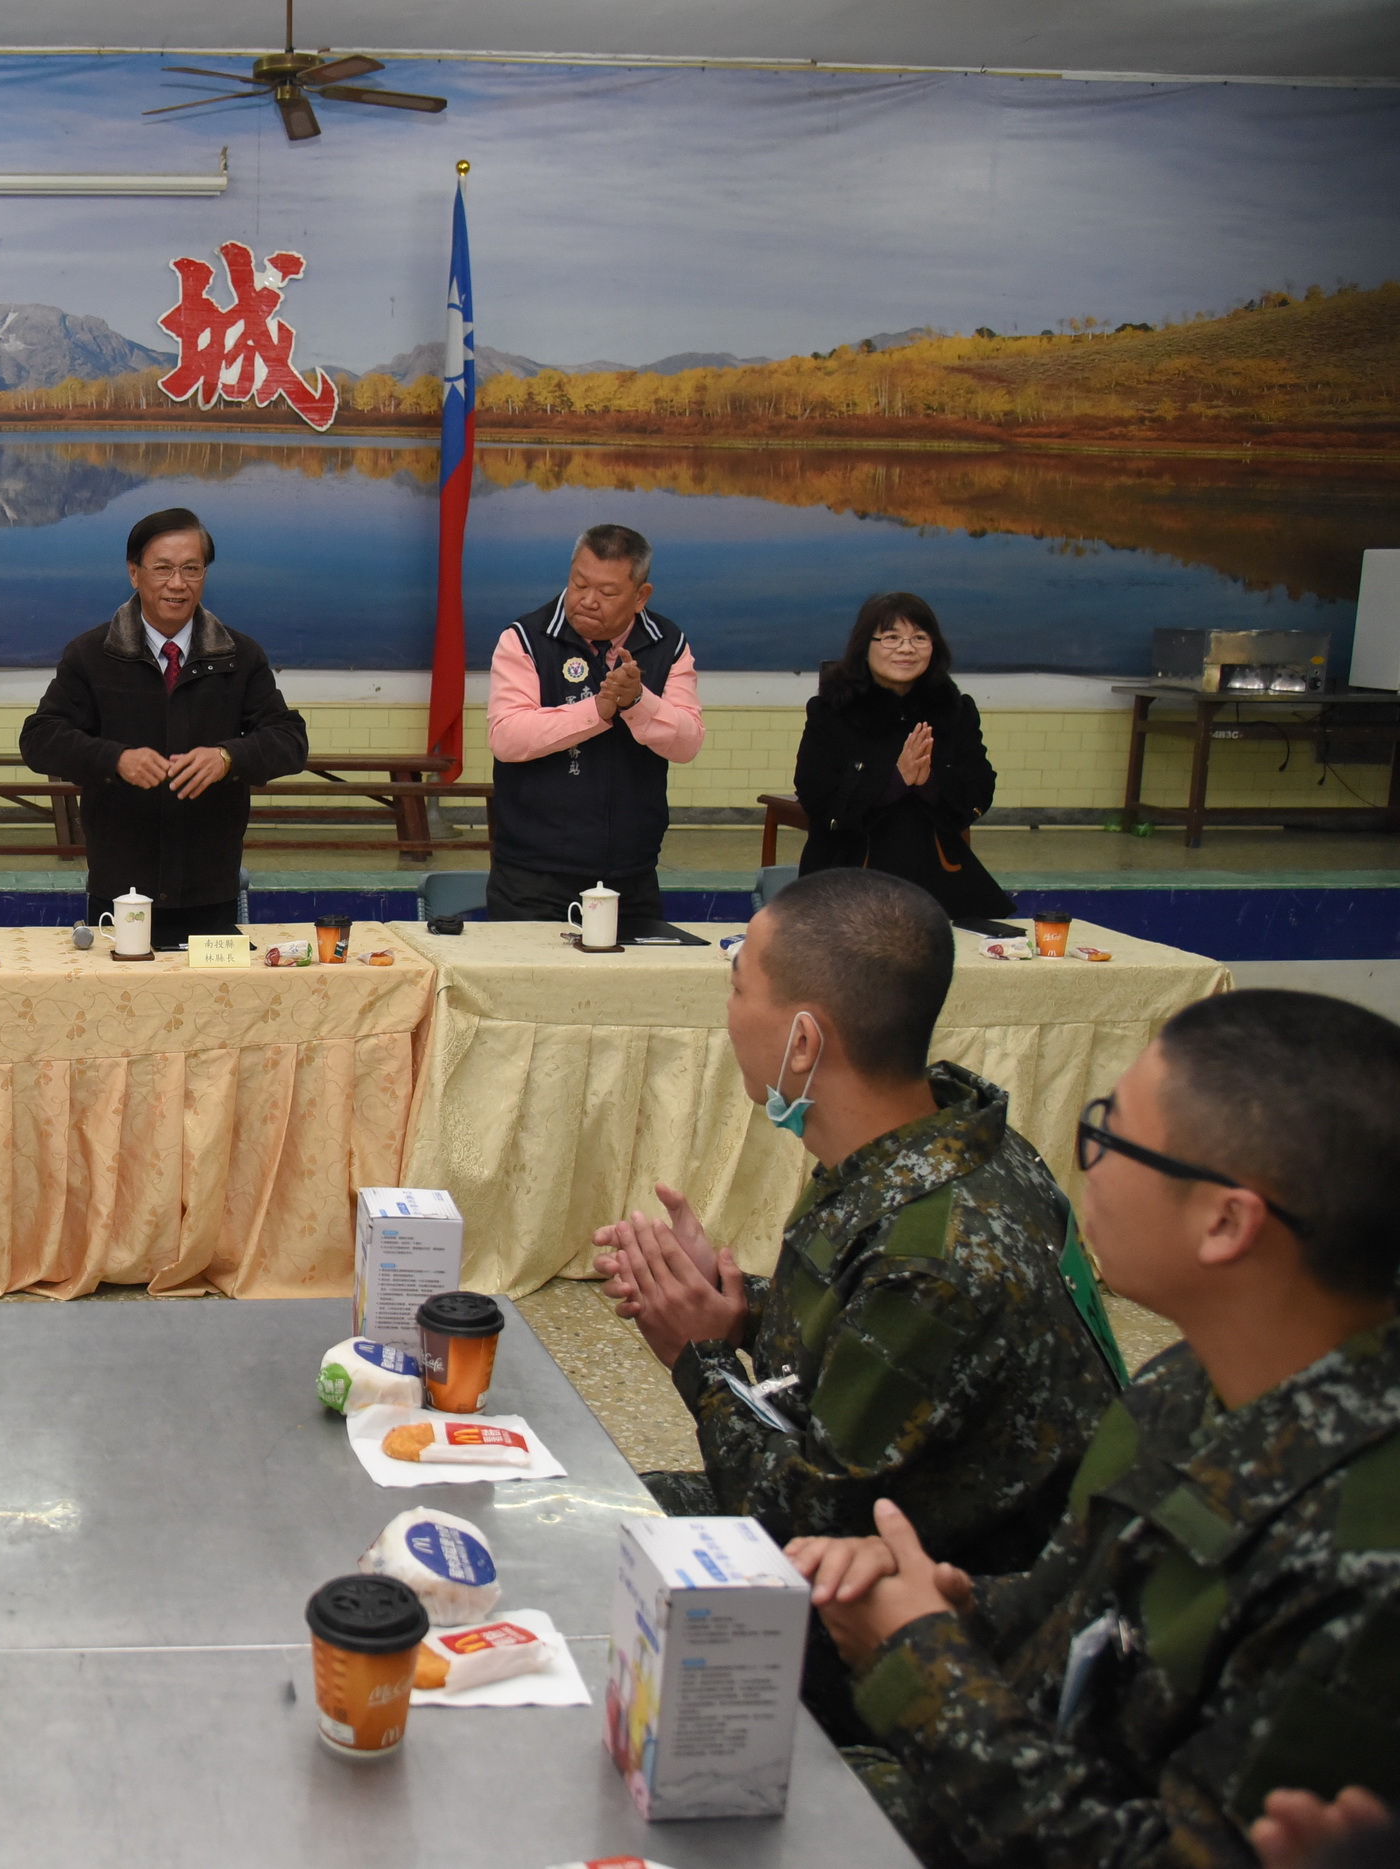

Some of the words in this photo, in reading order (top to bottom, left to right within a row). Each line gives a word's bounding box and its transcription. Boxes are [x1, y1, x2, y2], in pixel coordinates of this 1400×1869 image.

[204, 939, 235, 949] 南投縣
[205, 953, 236, 963] 林縣長
